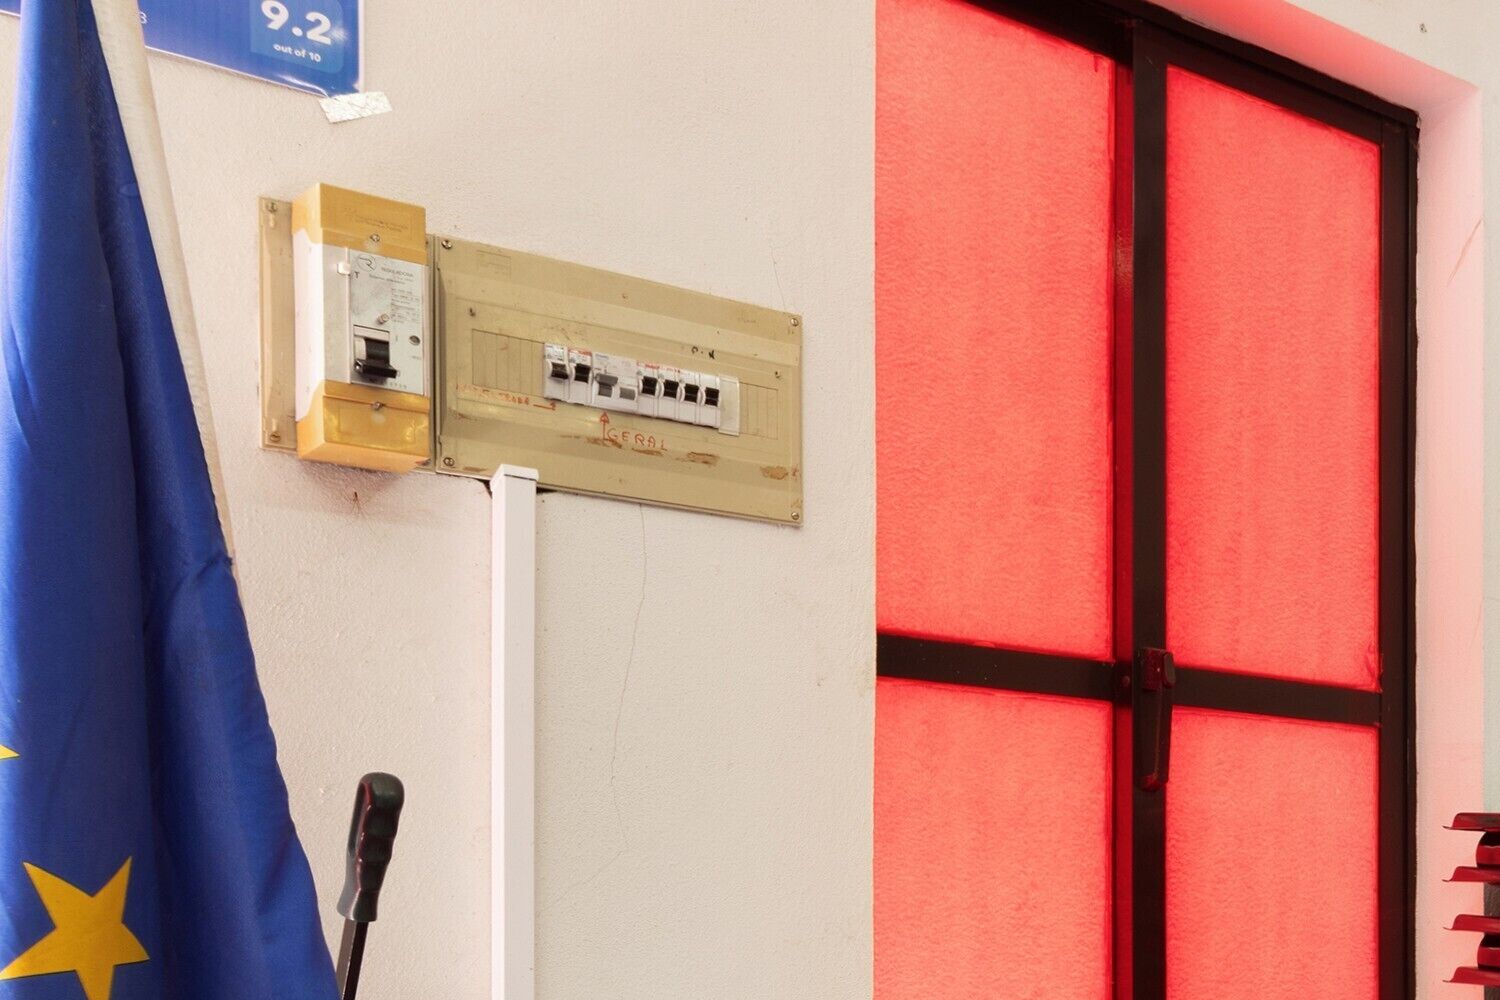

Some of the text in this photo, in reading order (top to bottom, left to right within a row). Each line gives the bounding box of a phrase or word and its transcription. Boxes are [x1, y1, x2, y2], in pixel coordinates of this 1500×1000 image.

[261, 0, 331, 45] 9.2
[273, 43, 321, 62] out of 10
[607, 427, 668, 451] GERAL
